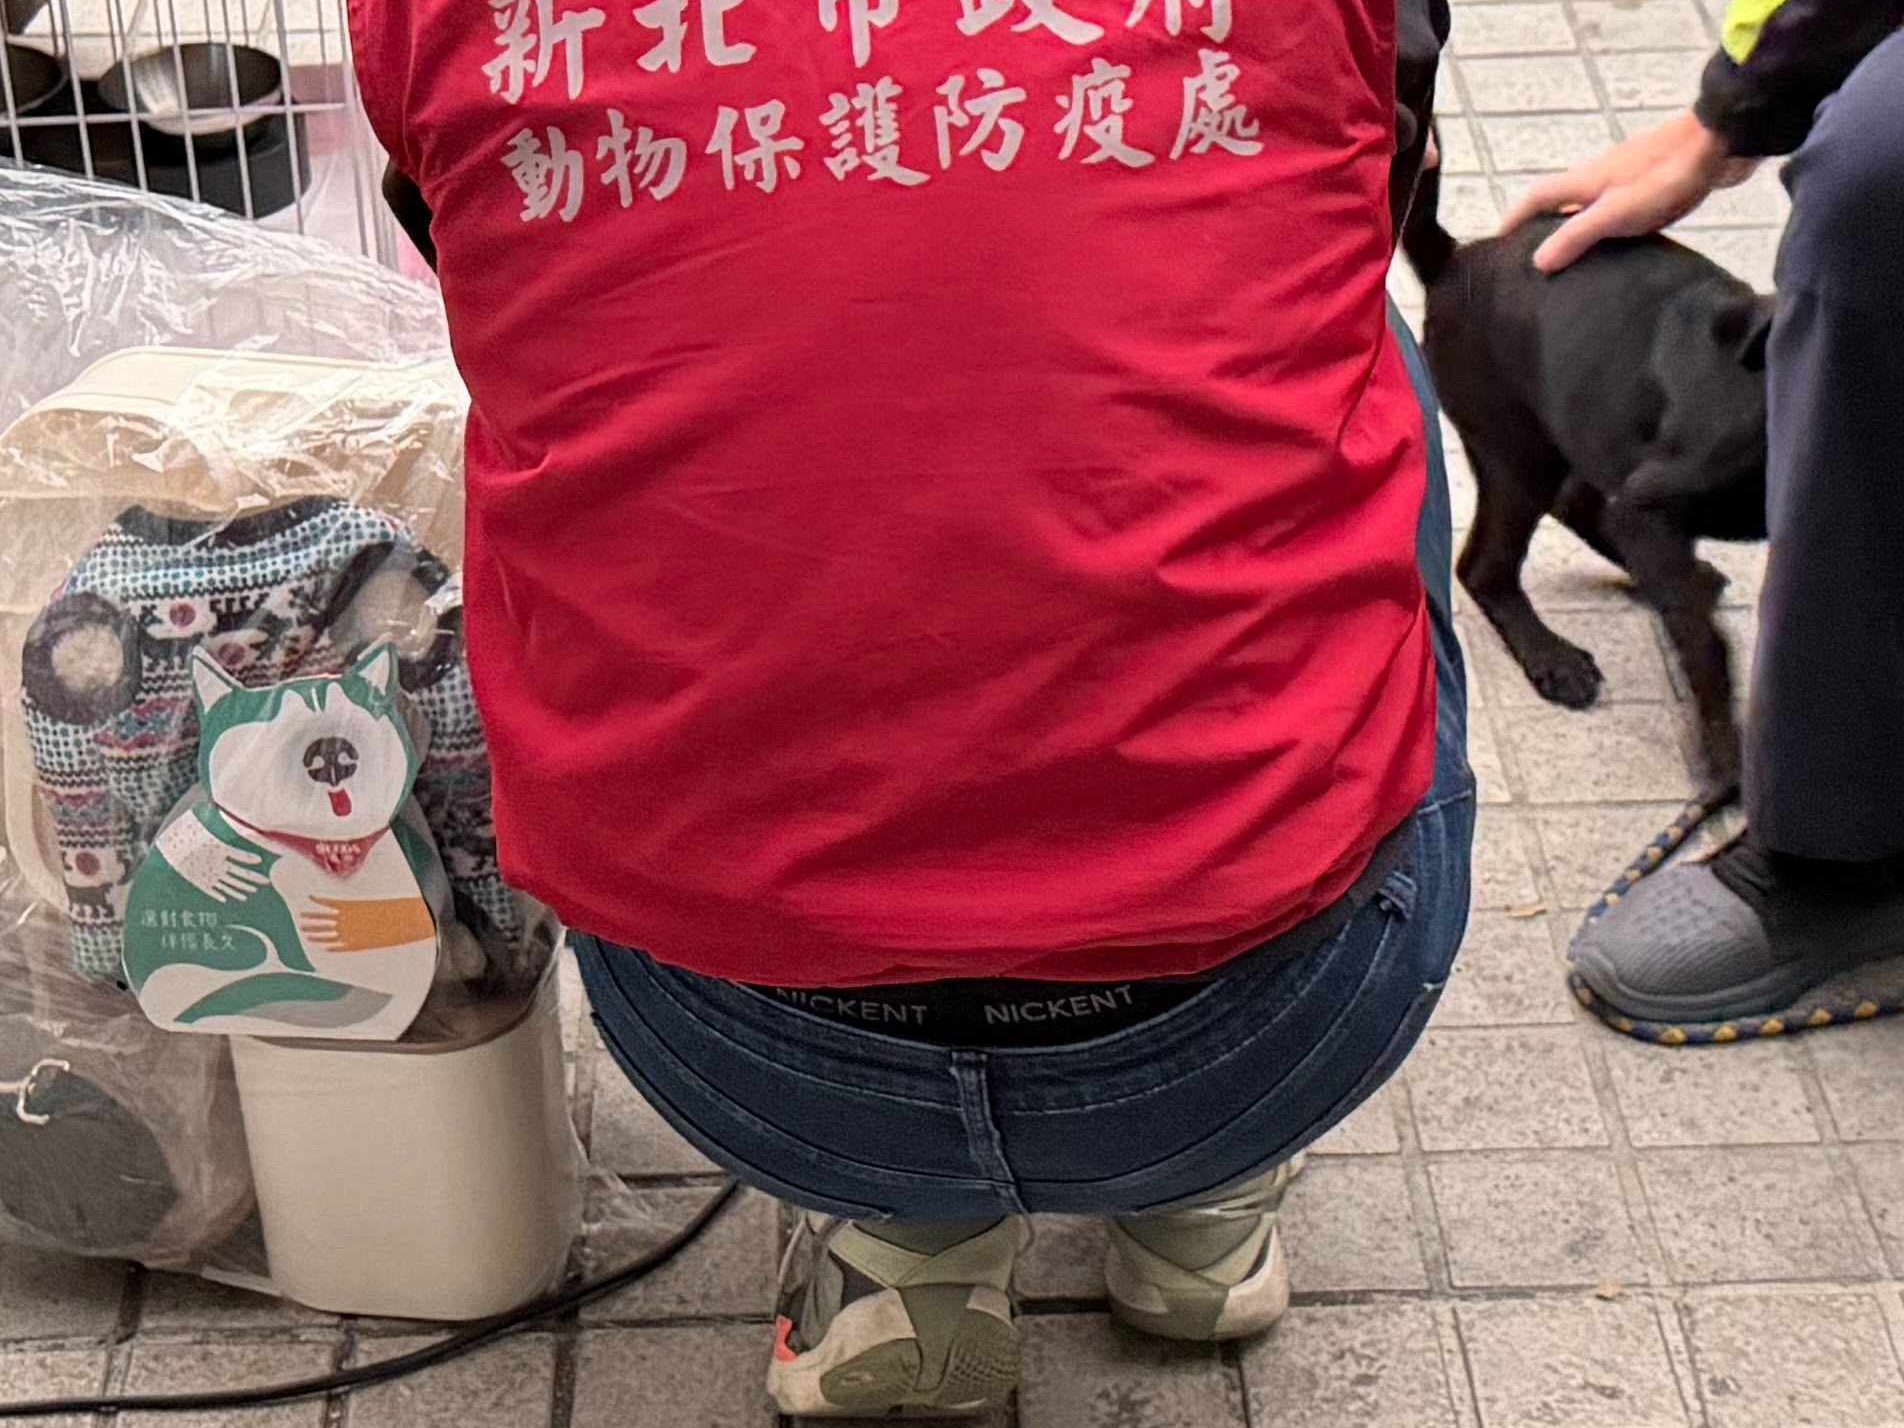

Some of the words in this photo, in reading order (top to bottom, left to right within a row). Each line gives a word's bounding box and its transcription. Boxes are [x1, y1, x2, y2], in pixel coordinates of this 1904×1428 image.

[500, 46, 1264, 222] 動物保護防疫處
[984, 984, 1132, 1025] NICKENT
